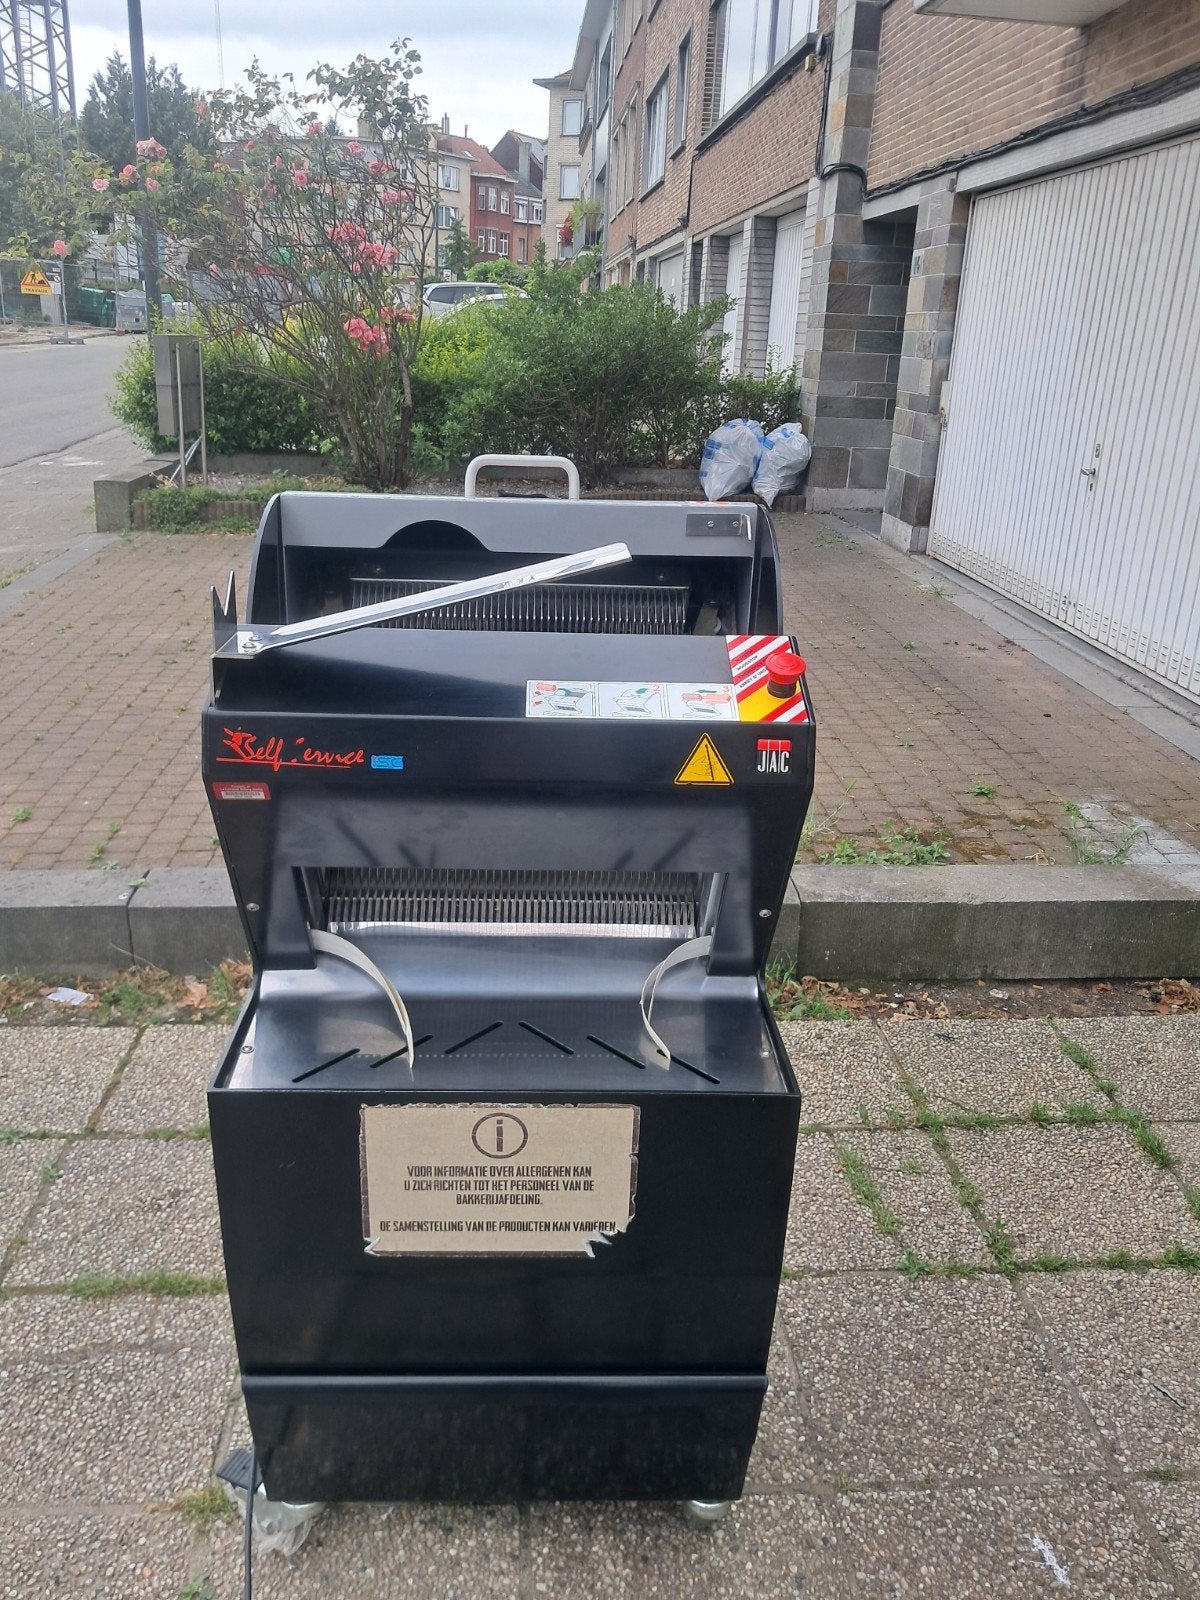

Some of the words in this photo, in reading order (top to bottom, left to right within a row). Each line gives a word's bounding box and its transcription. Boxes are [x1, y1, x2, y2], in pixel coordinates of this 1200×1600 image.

[757, 750, 790, 773] JAC
[407, 1165, 432, 1177] VOOR
[434, 1165, 488, 1177] INFORMATIE
[489, 1165, 514, 1177] OVER
[515, 1165, 572, 1177] ALLERGENEN
[573, 1165, 592, 1177] KAN
[404, 1180, 410, 1191] U
[412, 1180, 432, 1191] ZICH
[434, 1180, 471, 1191] RICHTEN
[473, 1180, 490, 1191] TOT
[491, 1180, 508, 1191] HET
[510, 1180, 560, 1191] PERSONEEL
[562, 1180, 581, 1191] VAN
[583, 1180, 595, 1191] DE
[456, 1193, 544, 1205] BAKKERIJAFDELING.
[380, 1220, 391, 1232] DE
[393, 1220, 464, 1232] SAMENSTELLING
[465, 1220, 484, 1232] VAN
[486, 1220, 498, 1232] DE
[499, 1220, 551, 1232] PRODUCTEN
[552, 1220, 571, 1232] KAN
